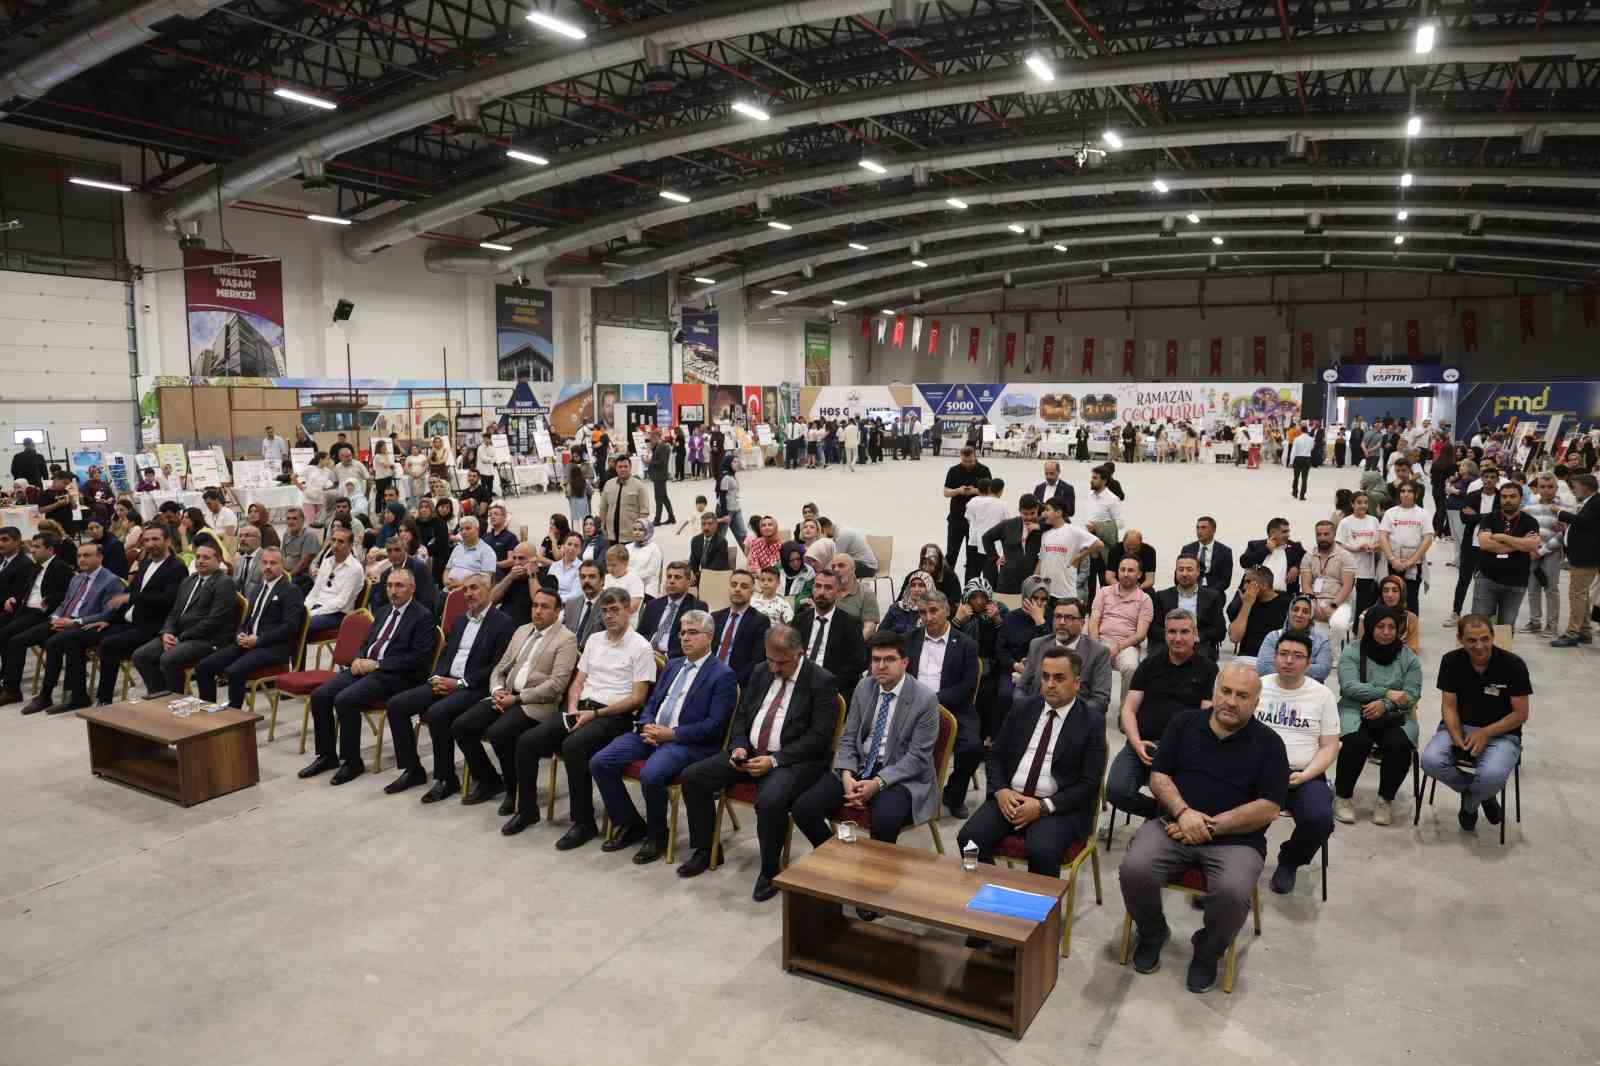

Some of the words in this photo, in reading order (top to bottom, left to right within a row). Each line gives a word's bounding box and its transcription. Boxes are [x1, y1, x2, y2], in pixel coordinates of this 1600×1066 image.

[220, 277, 252, 289] YAŞAM
[216, 288, 256, 300] MERKEZİ
[1372, 374, 1407, 382] YAPTIK
[1136, 388, 1194, 405] RAMAZAN
[945, 401, 974, 411] 5000
[1256, 711, 1310, 728] NAUTICA
